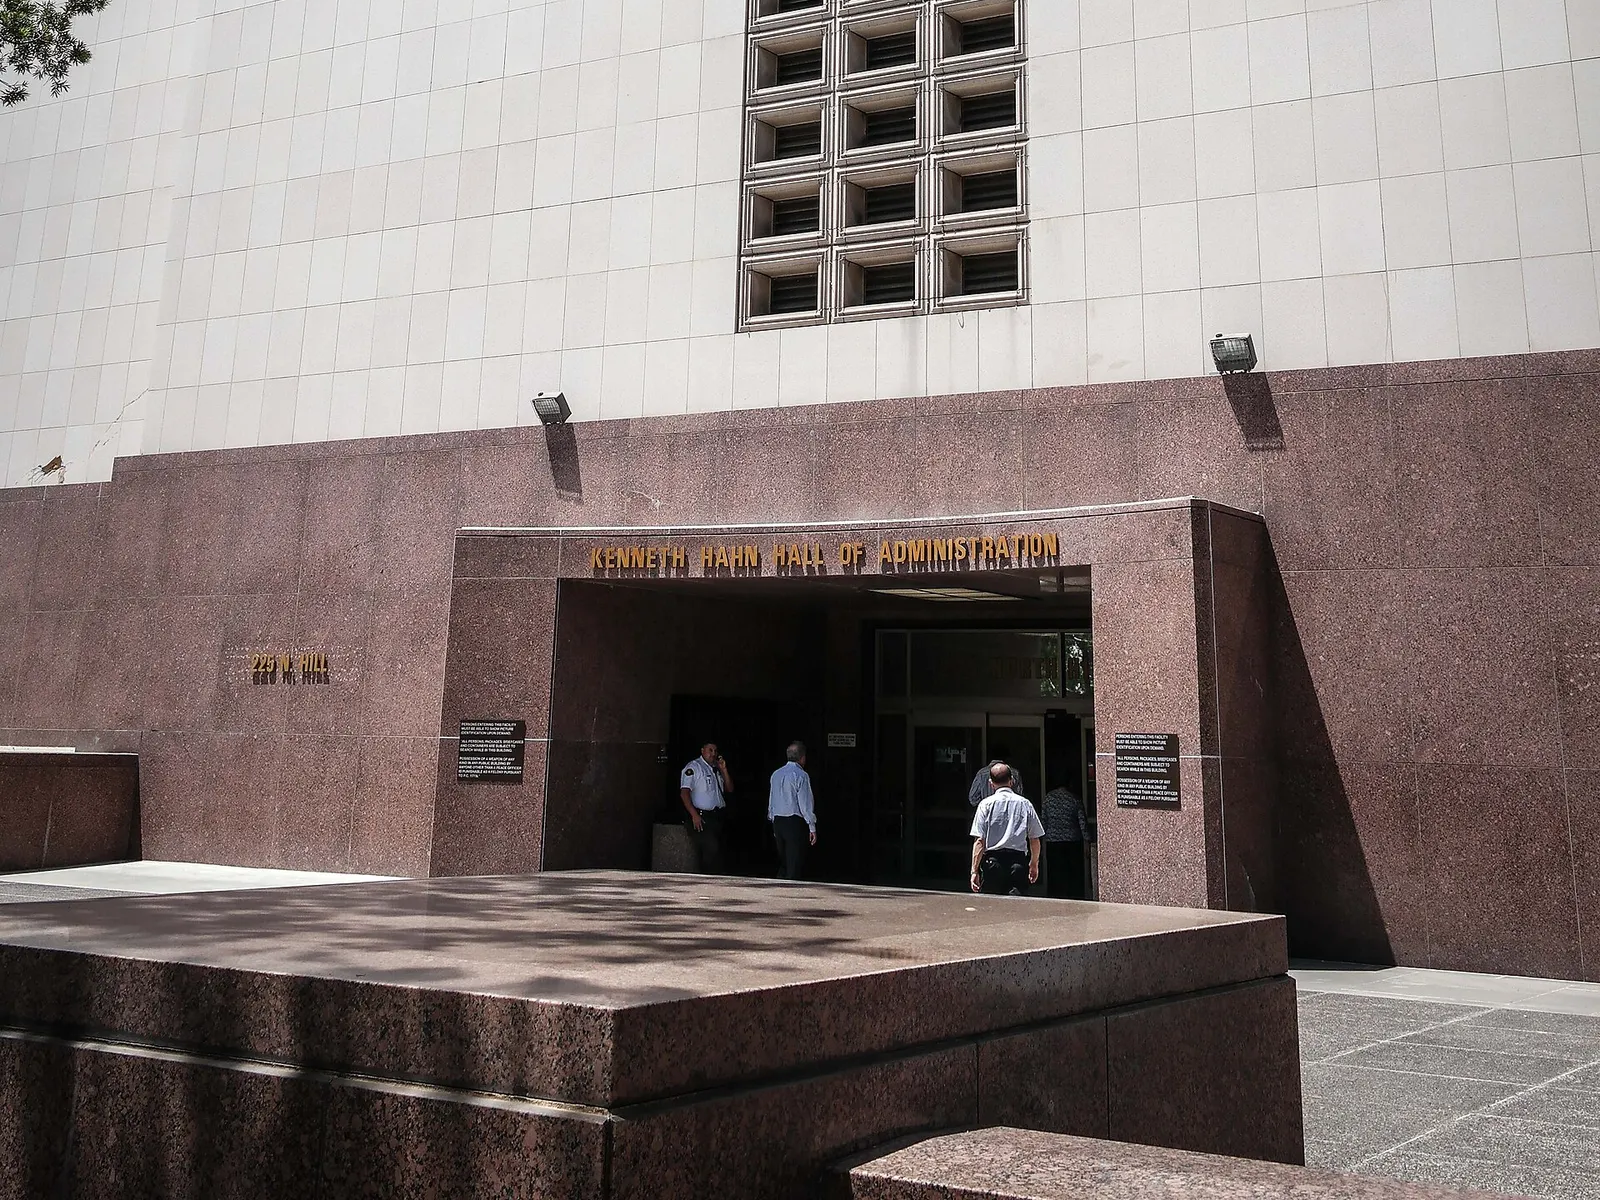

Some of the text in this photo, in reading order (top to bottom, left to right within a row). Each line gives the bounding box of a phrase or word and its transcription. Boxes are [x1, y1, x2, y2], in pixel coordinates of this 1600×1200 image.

[591, 533, 1056, 568] KENNETH HAHN HALL OF ADMINISTRATION
[252, 653, 275, 672] 225
[299, 653, 328, 672] HILL
